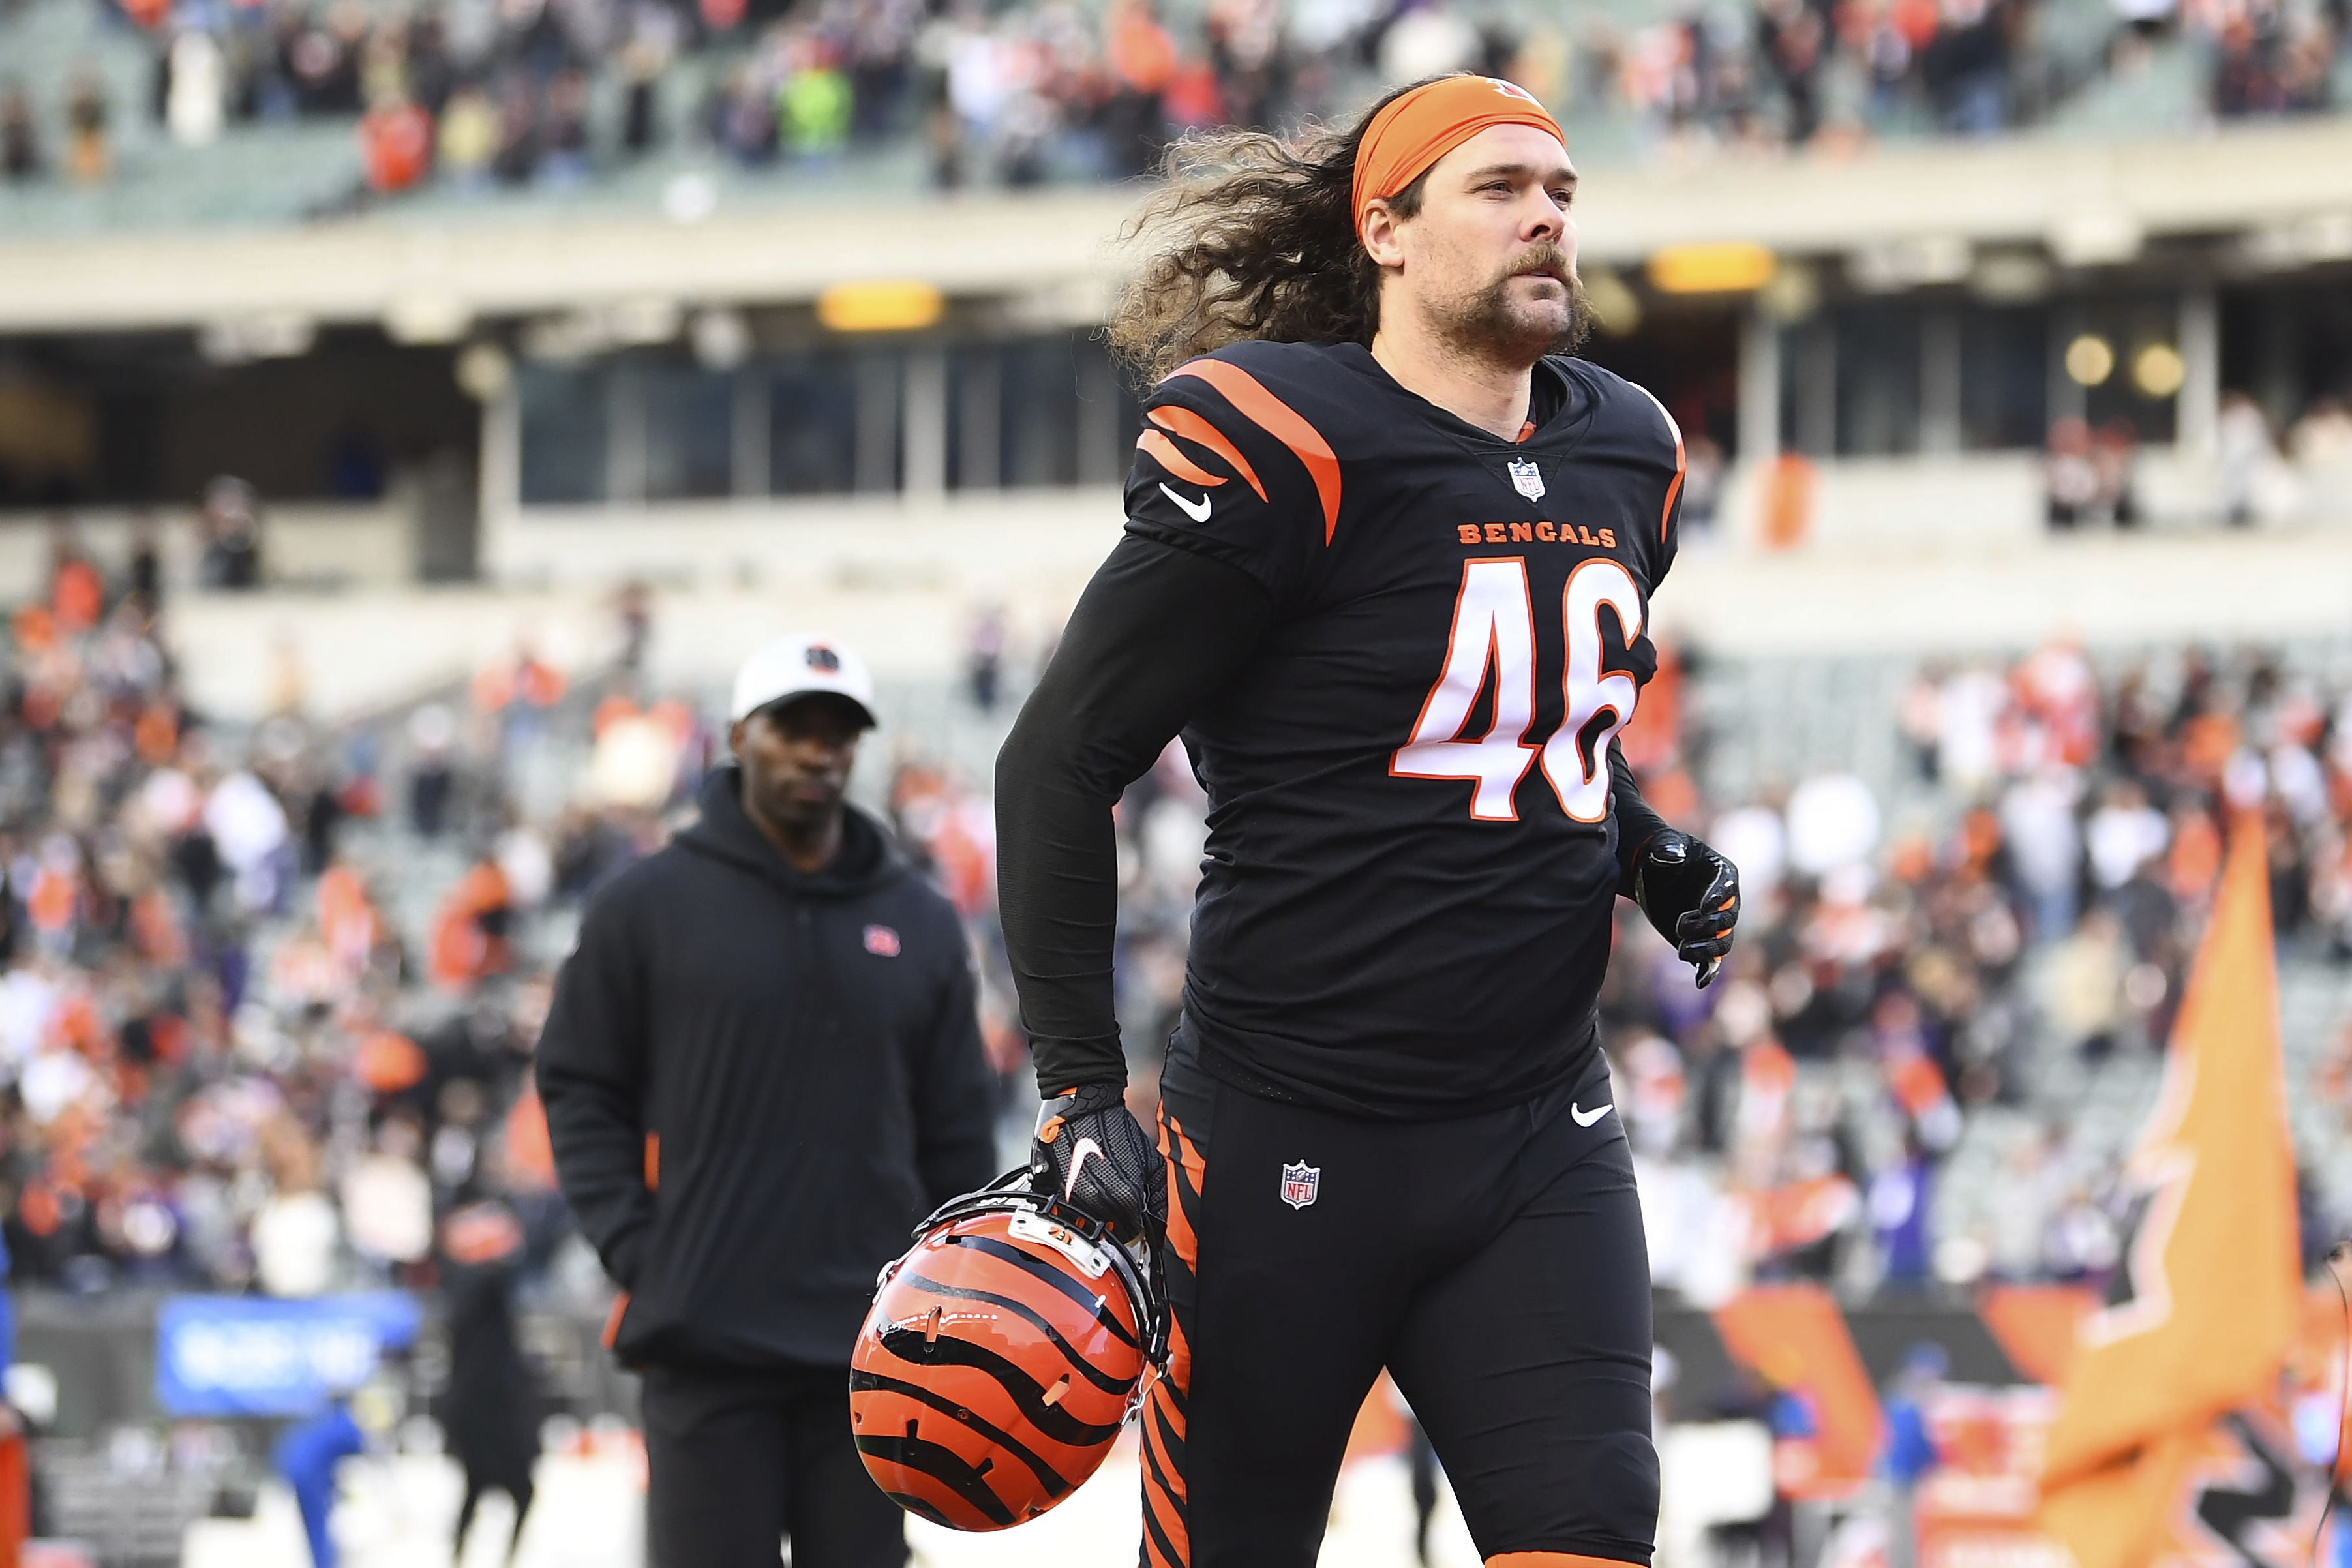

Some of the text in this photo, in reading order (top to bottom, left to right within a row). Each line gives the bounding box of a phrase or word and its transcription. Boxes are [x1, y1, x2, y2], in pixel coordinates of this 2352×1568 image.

[1518, 477, 1540, 492] NFL
[1457, 521, 1616, 549] BENGALS
[1389, 556, 1642, 823] 46
[1287, 1183, 1311, 1200] NFL
